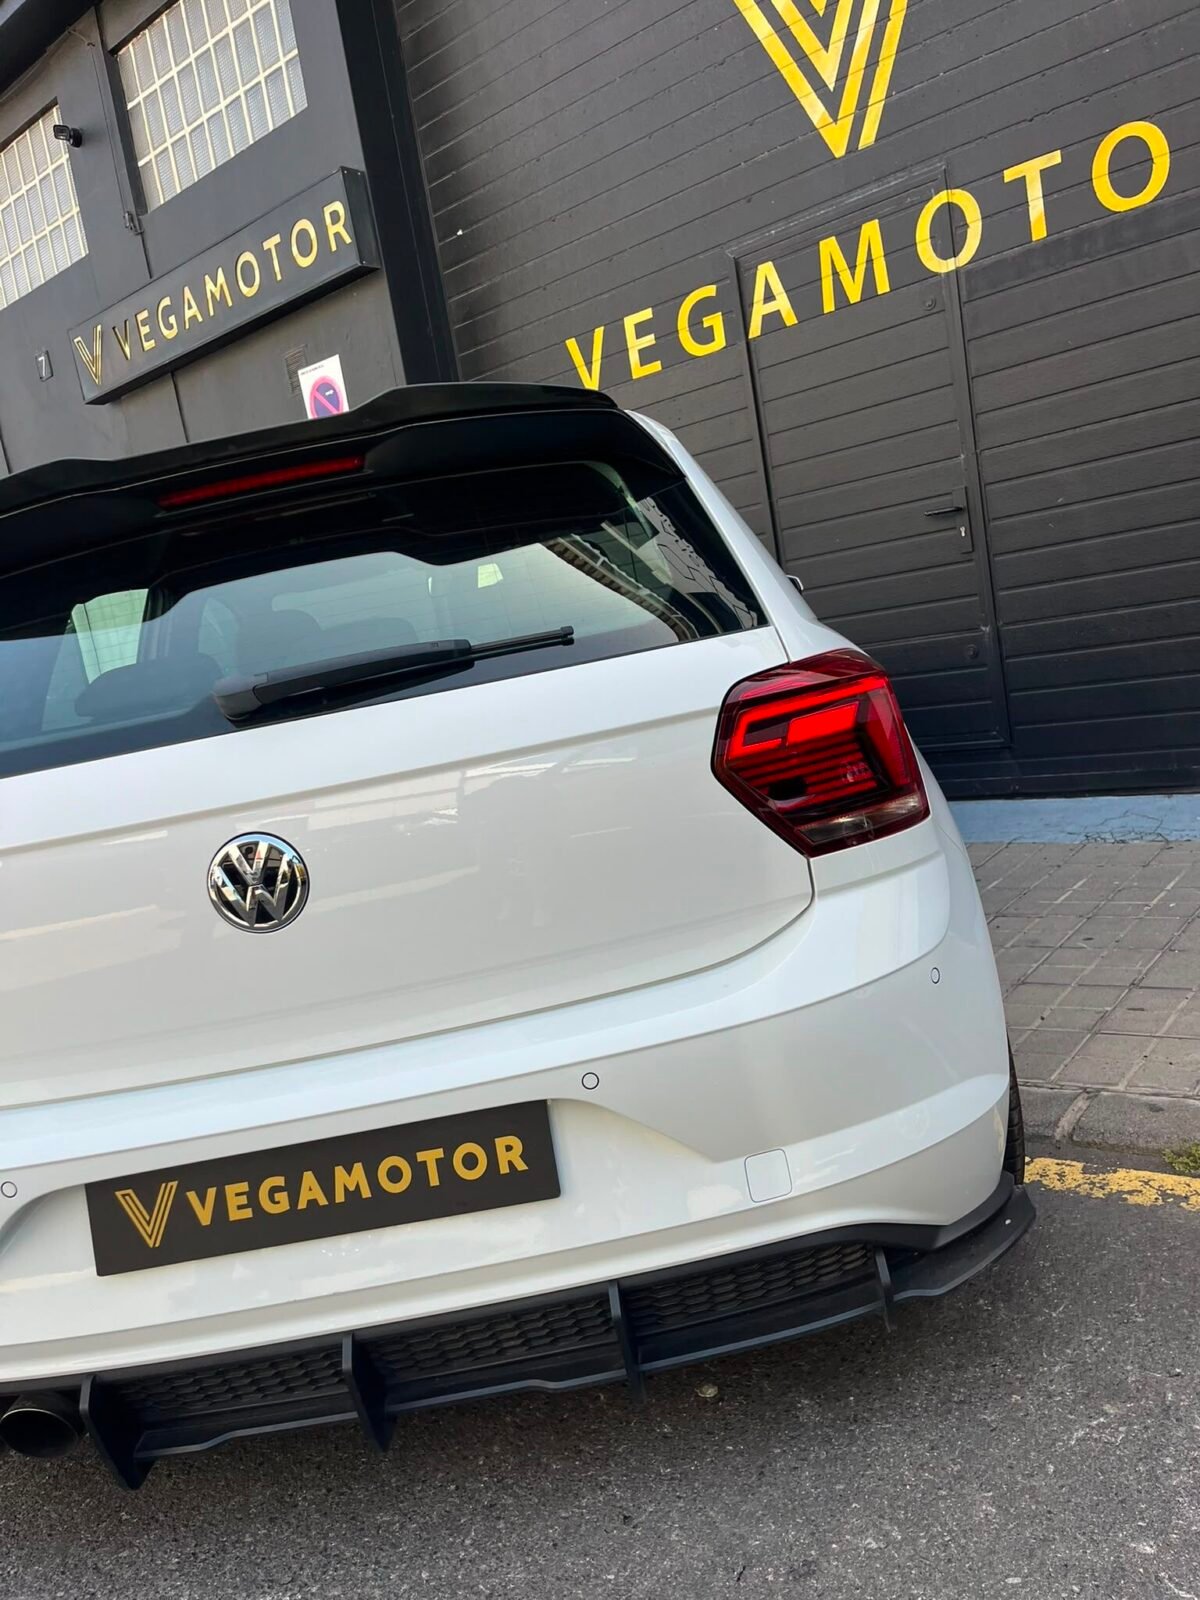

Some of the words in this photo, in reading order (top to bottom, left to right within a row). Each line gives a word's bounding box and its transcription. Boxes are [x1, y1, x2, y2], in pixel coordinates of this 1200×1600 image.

[112, 200, 353, 361] VEGAMOTOR
[566, 121, 1170, 391] VEGAMOTO
[186, 1135, 529, 1226] VEGAMOTOR
